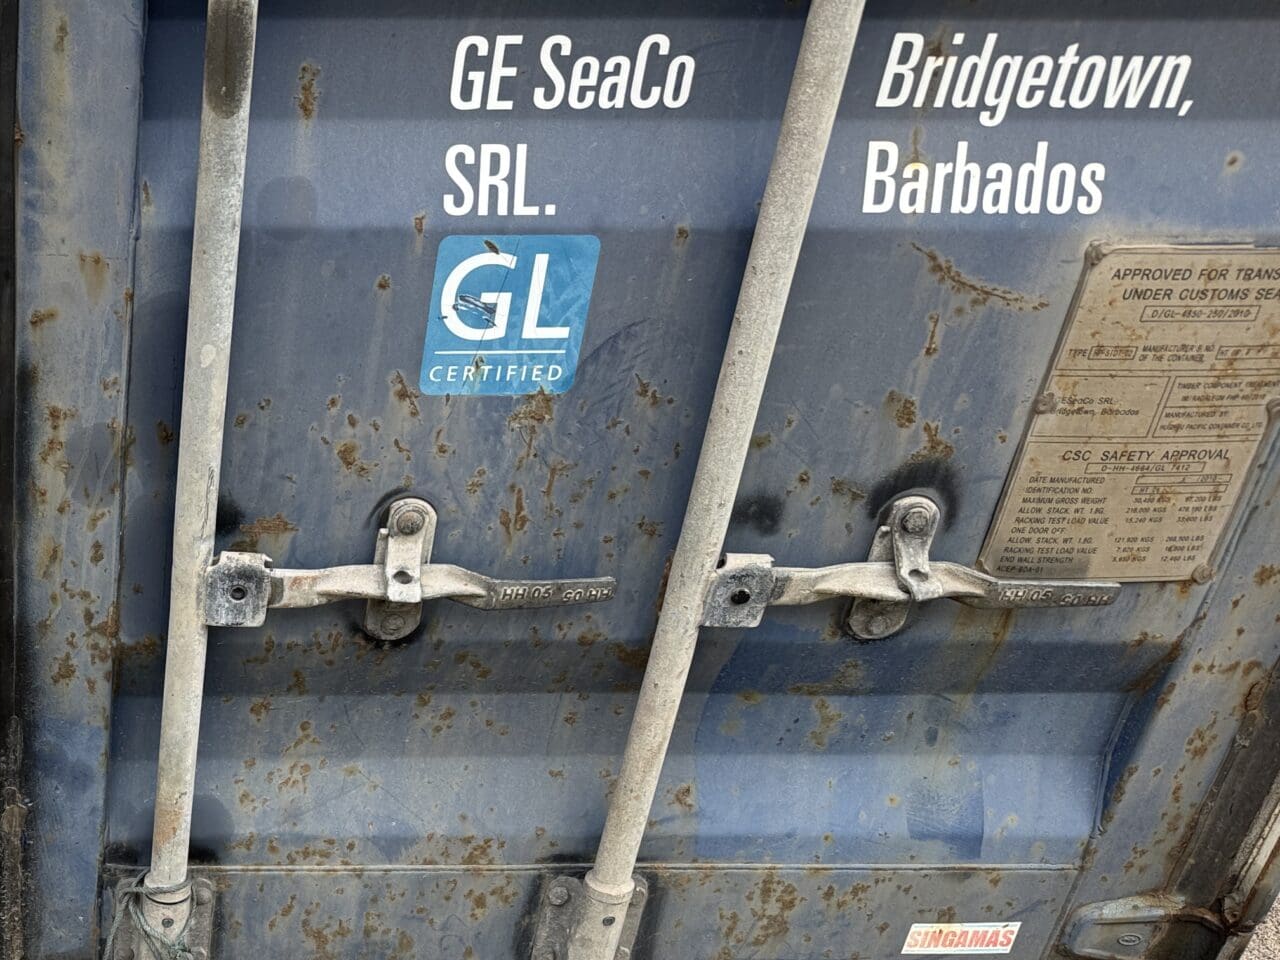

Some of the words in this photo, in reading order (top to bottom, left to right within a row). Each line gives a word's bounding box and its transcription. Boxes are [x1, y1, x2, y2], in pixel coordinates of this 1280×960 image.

[450, 34, 523, 110] GE
[533, 33, 696, 110] SeaCo
[875, 32, 1194, 127] Bridgetown,
[443, 143, 556, 216] SRL.
[862, 141, 1106, 215] Barbados
[1111, 268, 1193, 280] APPROVED
[1197, 268, 1229, 280] FOR
[440, 252, 570, 341] GL
[1122, 288, 1173, 300] UNDER
[1179, 288, 1250, 300] CUSTOMS
[429, 365, 563, 382] CERTIFIED
[1062, 450, 1092, 461] CSC
[1101, 450, 1155, 461] SAFETY
[1161, 449, 1230, 460] APPROVAL
[501, 587, 528, 600] HH
[906, 929, 1015, 948] SINGAMAS
